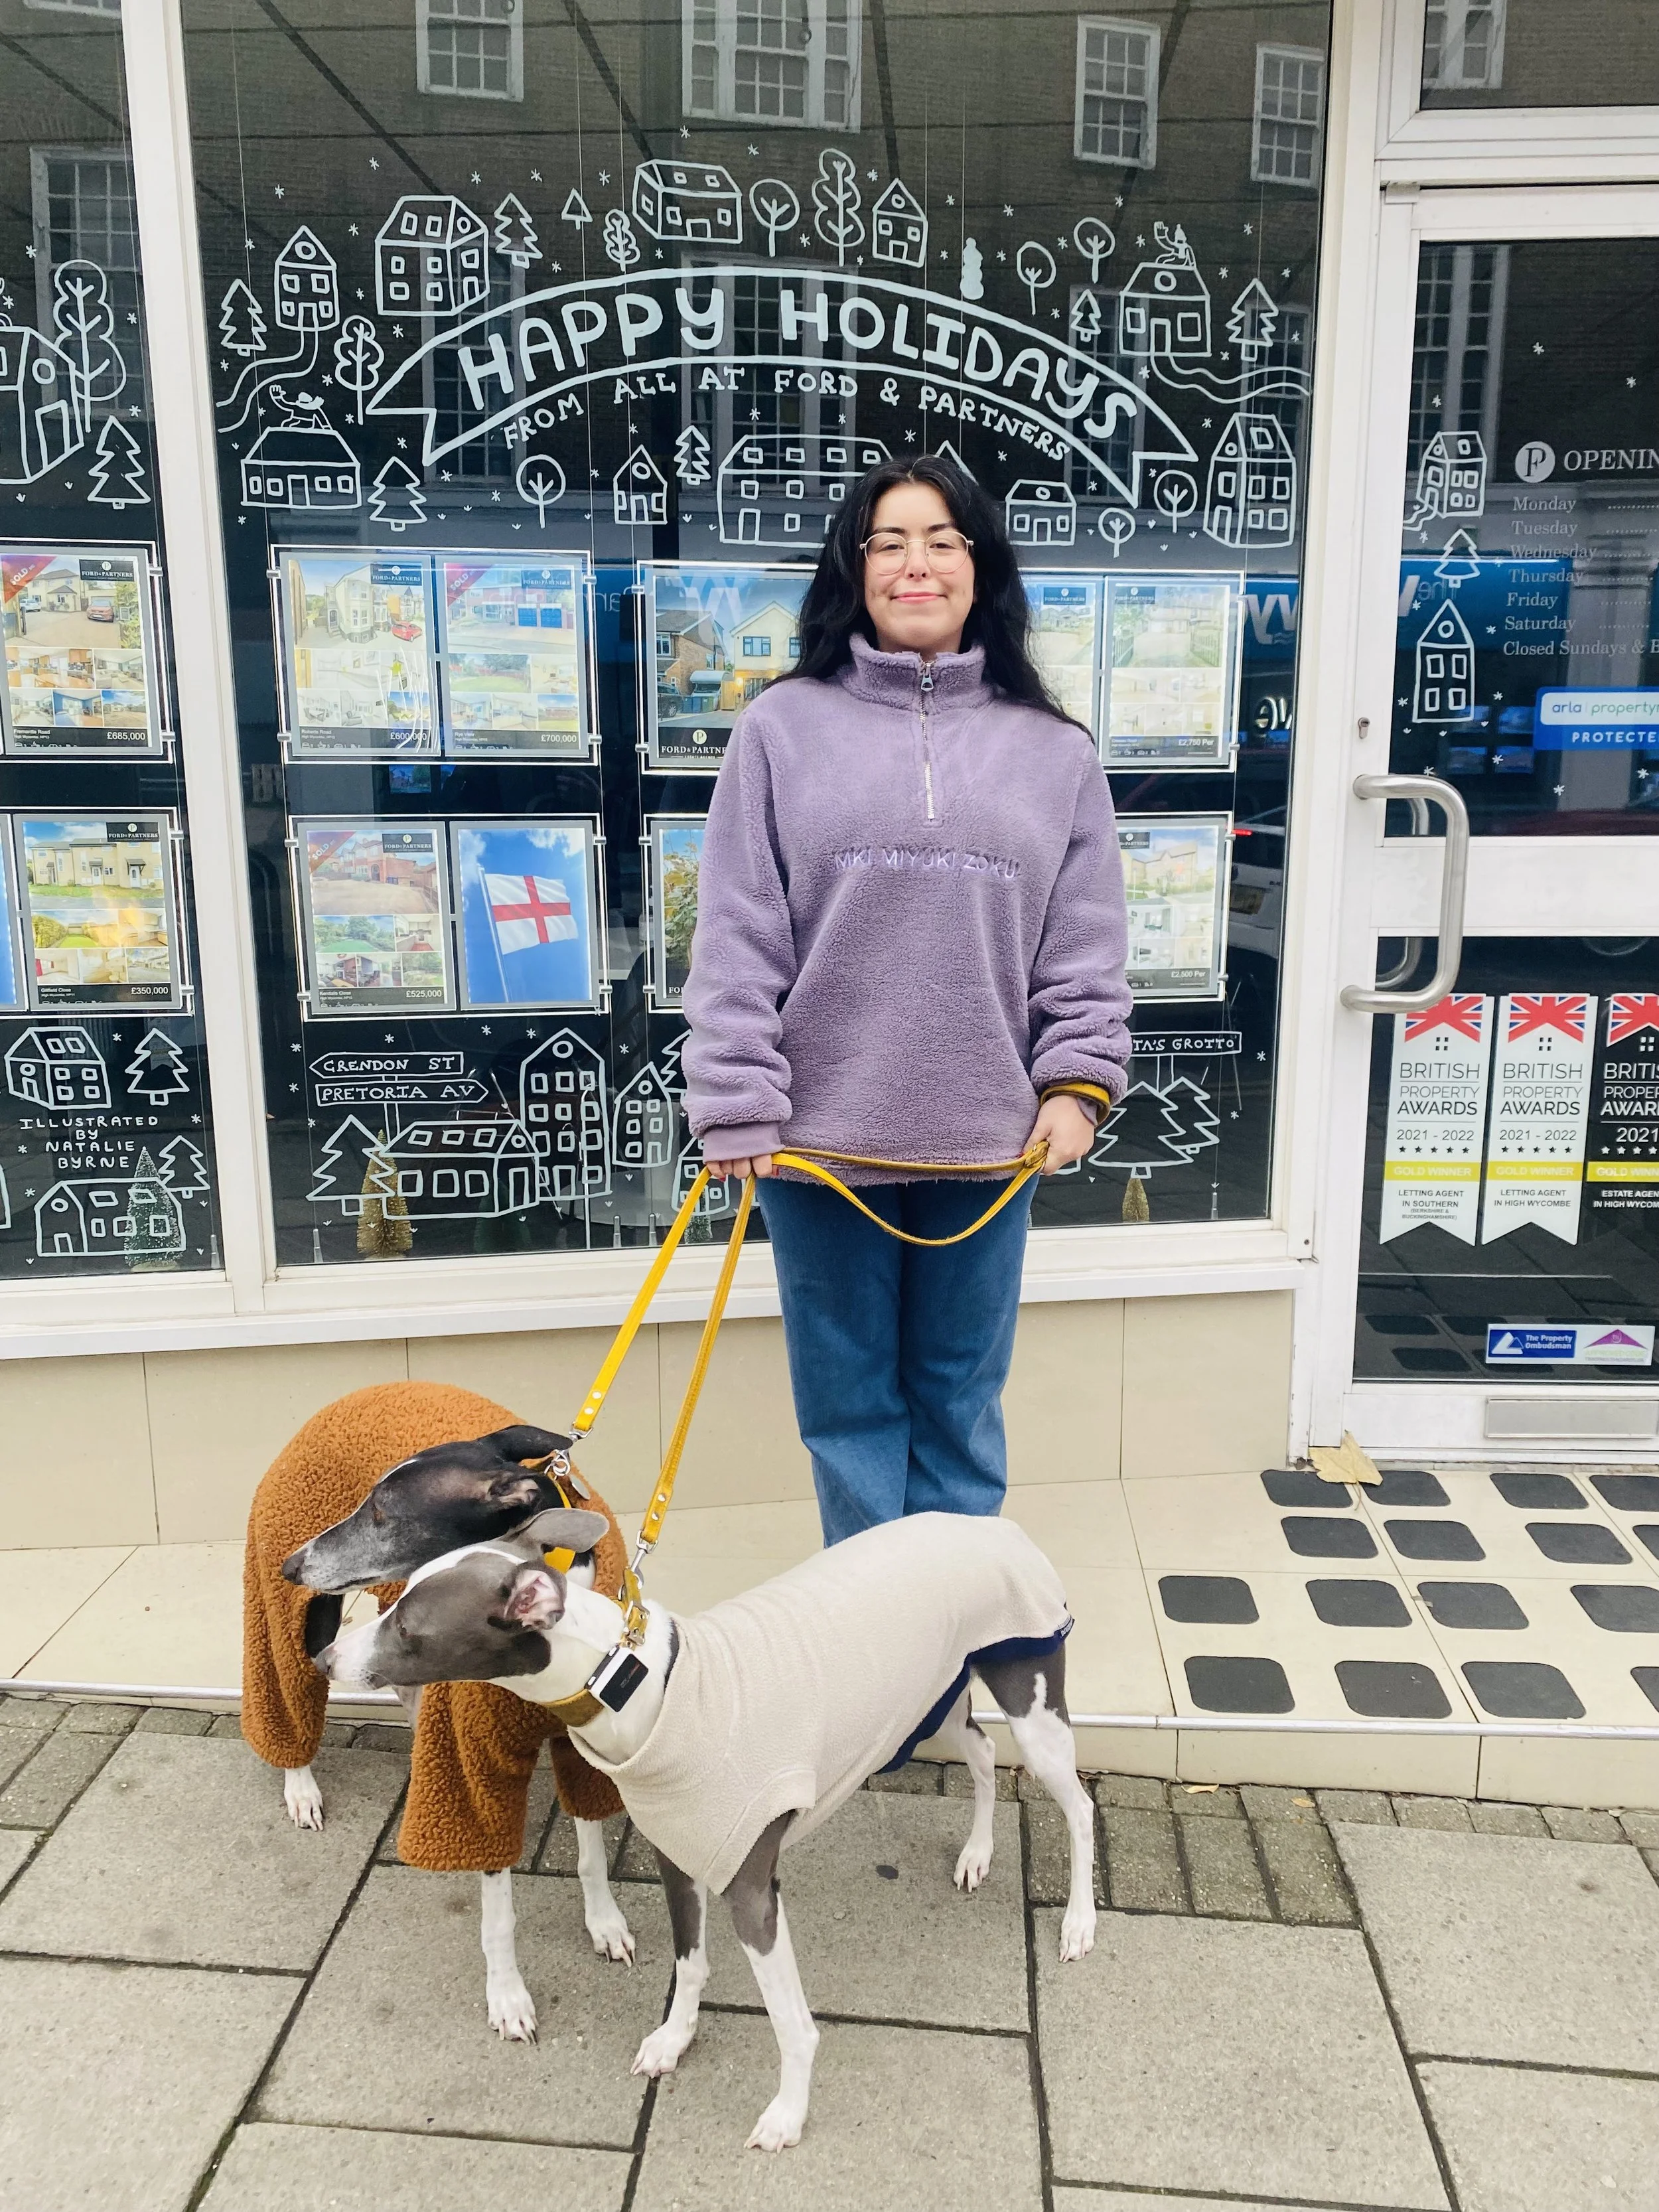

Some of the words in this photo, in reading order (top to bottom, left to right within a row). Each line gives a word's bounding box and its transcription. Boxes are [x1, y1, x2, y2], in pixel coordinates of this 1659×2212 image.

[458, 288, 724, 410] HAPPY
[780, 289, 1137, 439] HOLIDAYS
[503, 392, 584, 449] FROM
[614, 372, 676, 404] ALL
[698, 366, 746, 391] AT
[774, 369, 858, 397] FORD
[880, 378, 900, 406] &
[918, 386, 1070, 461] PARTNERS
[1563, 448, 1659, 471] OPENIN
[1512, 495, 1577, 514] Monday
[1511, 519, 1579, 538] Tuesday
[1510, 542, 1597, 561] Wednesday
[10, 567, 29, 585] SOLD
[450, 573, 469, 591] SOLD
[1508, 567, 1584, 584] Thursday
[1506, 592, 1559, 609] Friday
[1505, 615, 1576, 632] Saturday
[1503, 640, 1555, 656] Closed
[1559, 639, 1626, 657] Sundays
[1631, 638, 1645, 654] &
[1552, 701, 1582, 713] arla
[1591, 701, 1659, 716] property
[107, 731, 146, 741] £685,000
[1571, 731, 1659, 743] PROTECTE
[312, 843, 329, 860] SOLD
[1133, 1038, 1166, 1051] TA'S
[1172, 1038, 1234, 1051] GROTTO
[428, 1057, 455, 1070] ST
[1400, 1063, 1480, 1079] BRITISH
[1503, 1063, 1583, 1079] BRITISH
[321, 1085, 428, 1101] PRETORIA
[440, 1084, 475, 1098] AV
[1400, 1086, 1480, 1098] PROPERTY
[1503, 1086, 1583, 1098] PROPERTY
[1604, 1086, 1659, 1098] PROPE
[1397, 1100, 1478, 1115] AWARDS
[1500, 1101, 1581, 1115] AWARDS
[1600, 1101, 1659, 1116] AWAR
[19, 1116, 159, 1130] ILLUSTRATED
[76, 1129, 98, 1140] BY
[1396, 1130, 1428, 1140] 2021
[1442, 1130, 1475, 1141] 2022
[1499, 1130, 1530, 1140] 2021
[1545, 1130, 1577, 1141] 2022
[1615, 1127, 1658, 1142] 2021
[45, 1141, 135, 1153] NATALIE
[58, 1156, 130, 1169] BYRNE
[1394, 1167, 1424, 1175] GOLD
[1428, 1167, 1472, 1176] WINNER
[1496, 1166, 1527, 1175] GOLD
[1530, 1167, 1573, 1176] WINNER
[1597, 1167, 1626, 1177] GOLD
[1630, 1167, 1659, 1177] WINN
